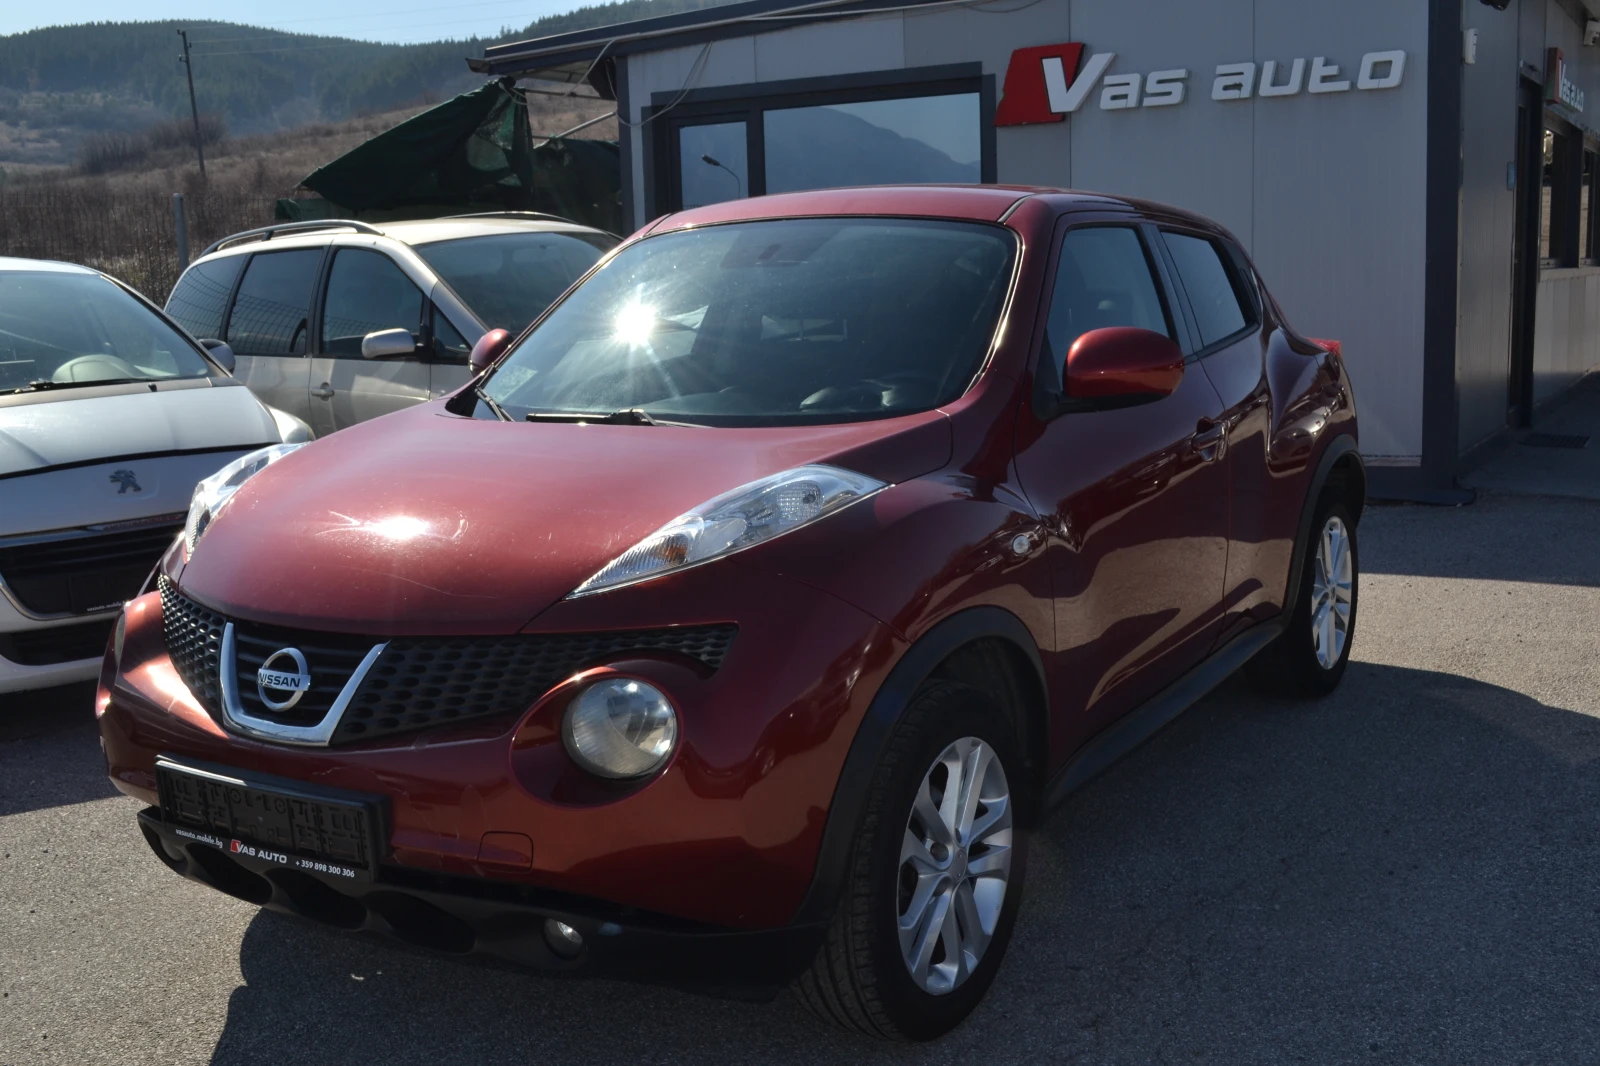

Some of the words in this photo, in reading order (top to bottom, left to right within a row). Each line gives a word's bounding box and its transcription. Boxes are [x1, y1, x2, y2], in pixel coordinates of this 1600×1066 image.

[1042, 52, 1189, 114] Vas
[1210, 49, 1407, 101] auto
[259, 672, 301, 687] NISSAN
[175, 828, 223, 849] vasauto.mobile.bg
[235, 842, 256, 857] VAS
[257, 849, 288, 864] AUTO
[301, 859, 314, 870] 359
[314, 862, 328, 872] 898
[327, 864, 342, 875] 300
[341, 866, 355, 878] 306
